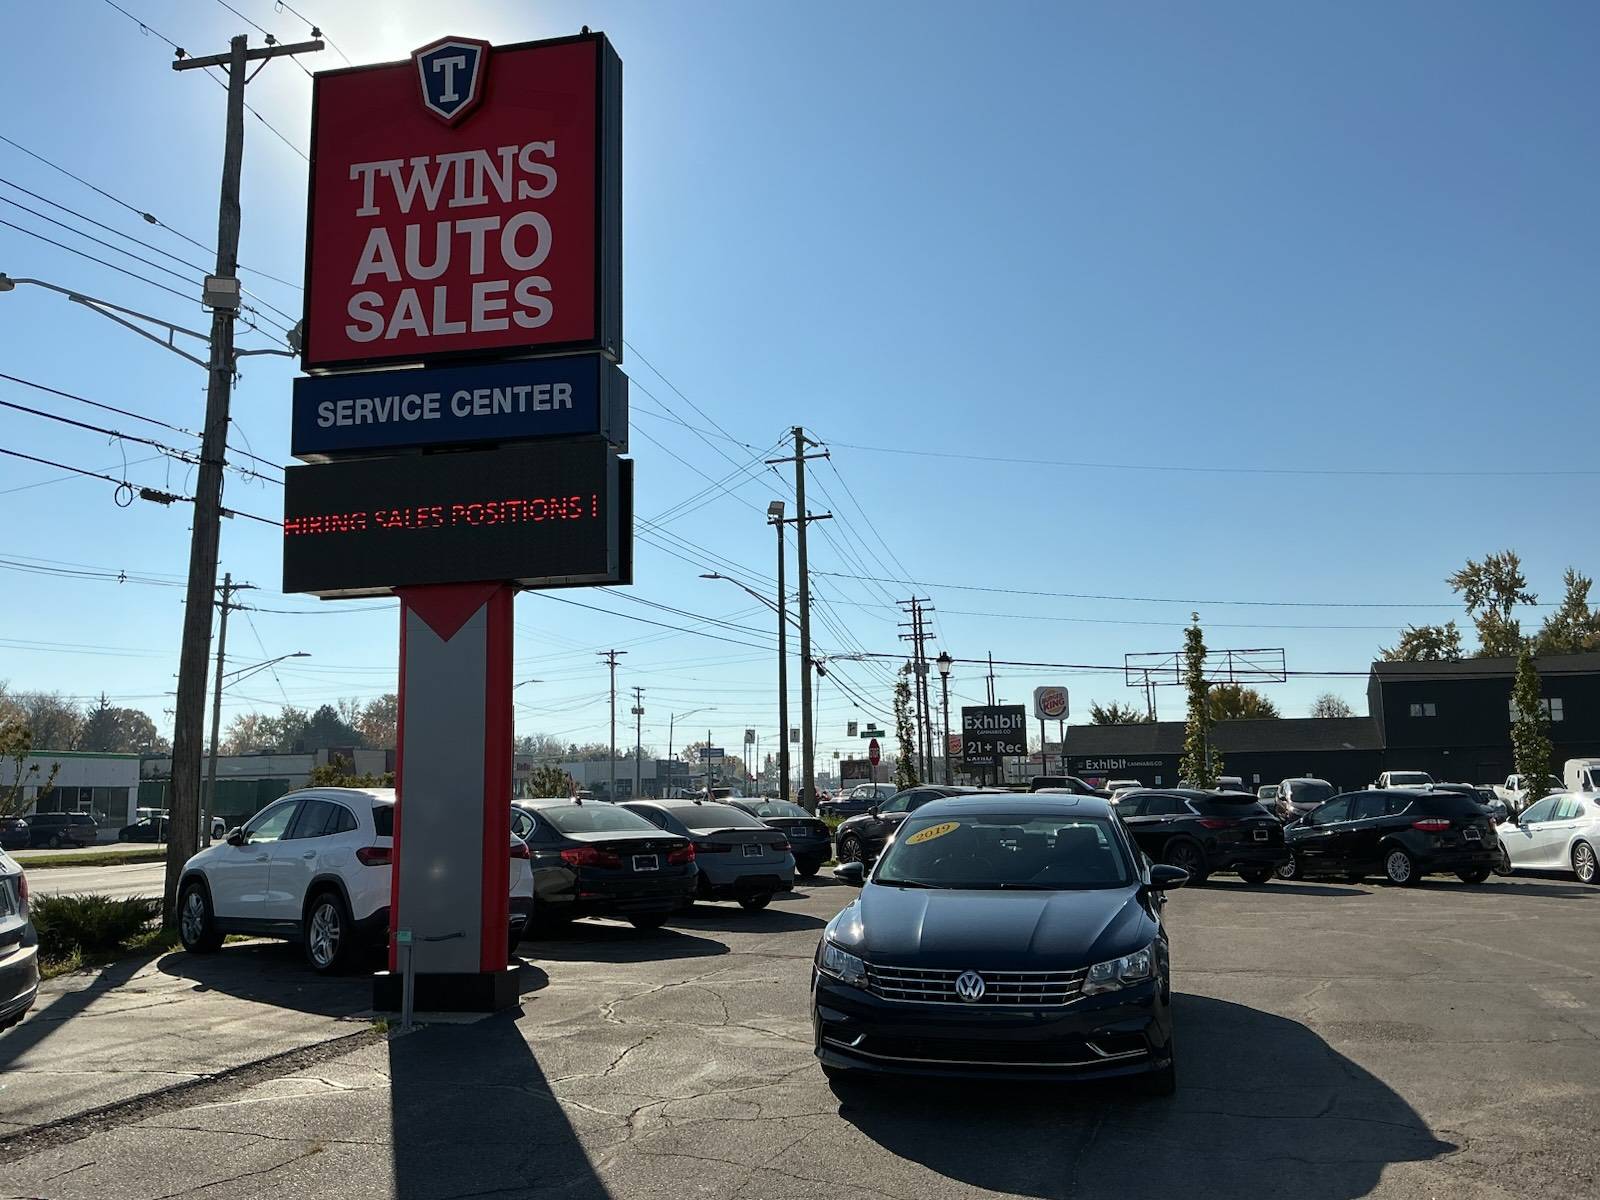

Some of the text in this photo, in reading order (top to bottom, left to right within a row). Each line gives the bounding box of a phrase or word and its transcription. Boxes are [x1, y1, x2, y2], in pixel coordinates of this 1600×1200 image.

[432, 55, 466, 103] T
[349, 140, 558, 217] TWINS
[351, 211, 553, 285] AUTO
[345, 275, 554, 343] SALES
[317, 382, 573, 428] SERVICE CENTER
[284, 511, 367, 535] HIRING
[375, 505, 444, 530] SALES
[452, 495, 583, 527] POSITIONS
[1043, 698, 1065, 711] KING
[997, 740, 1022, 753] Rec
[916, 824, 951, 842] 2019
